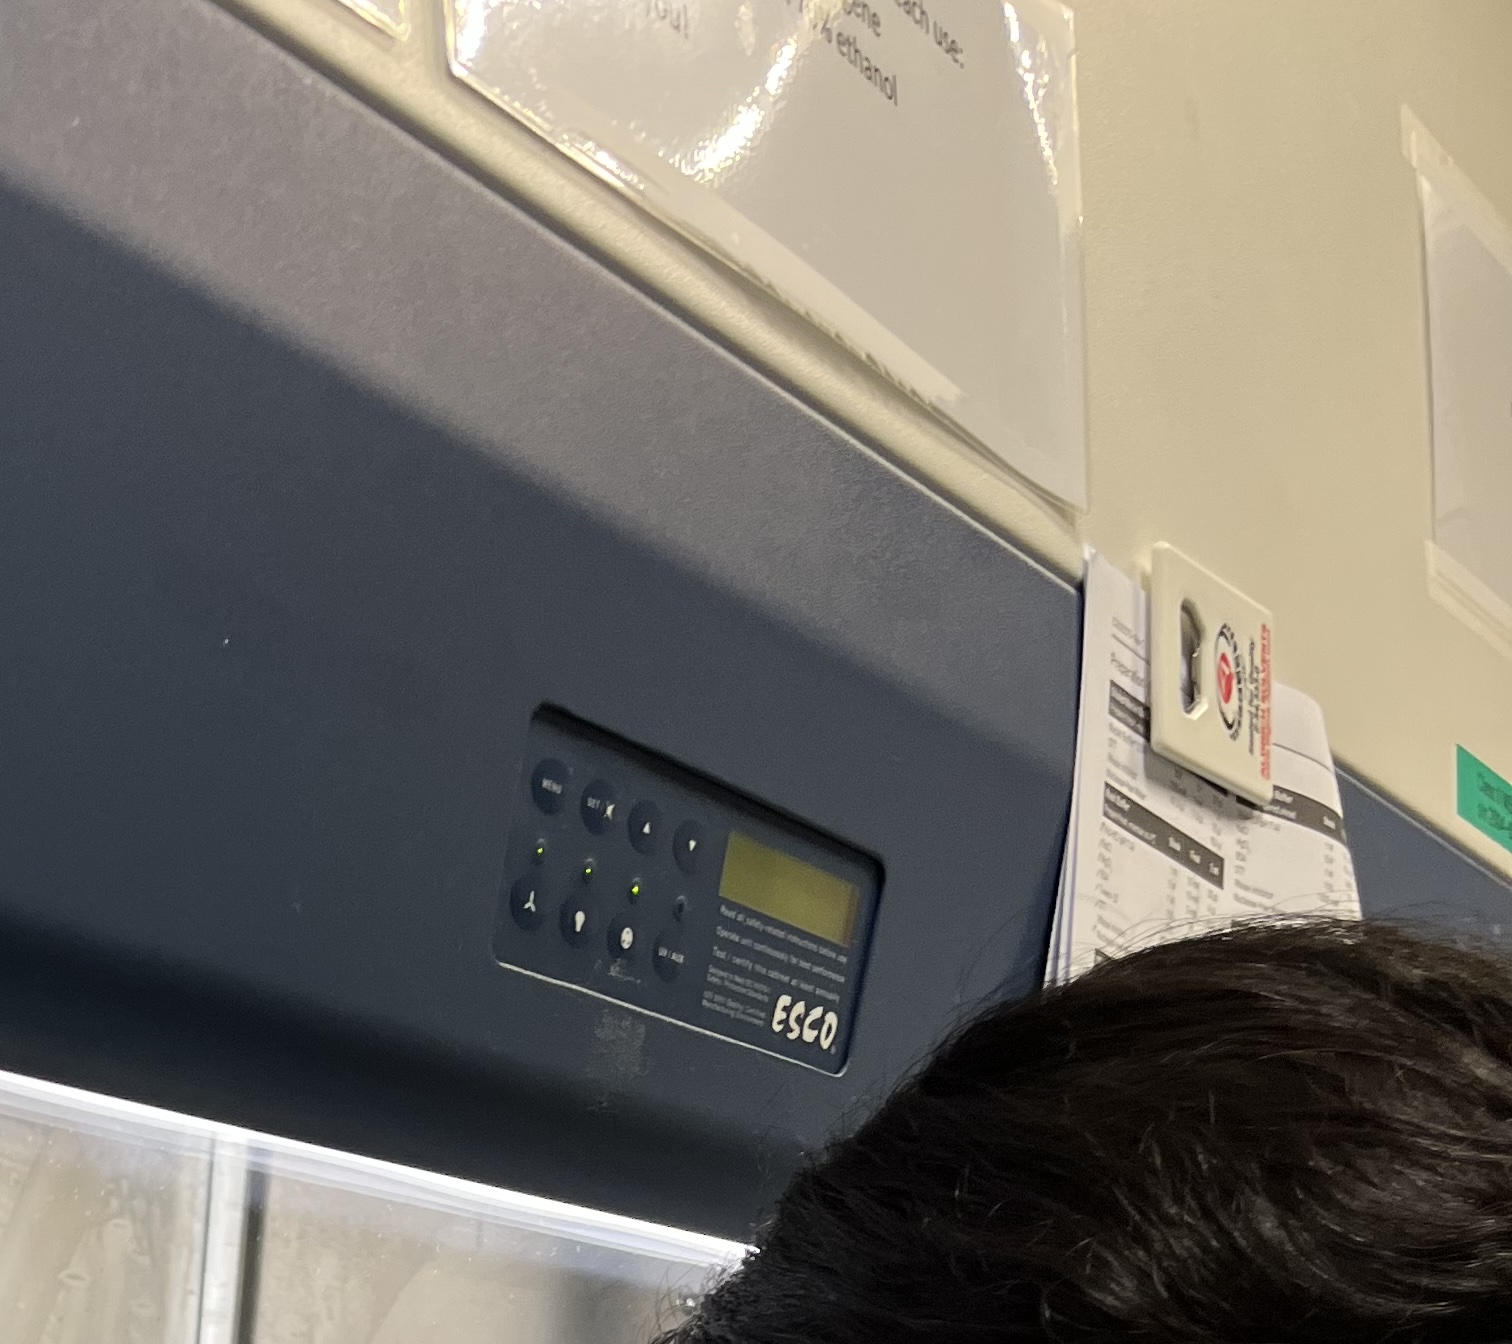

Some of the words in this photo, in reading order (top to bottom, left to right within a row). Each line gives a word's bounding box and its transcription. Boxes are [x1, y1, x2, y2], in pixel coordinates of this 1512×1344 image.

[836, 31, 898, 107] ethanol
[933, 20, 964, 69] use:
[771, 994, 838, 1050] ESCO
